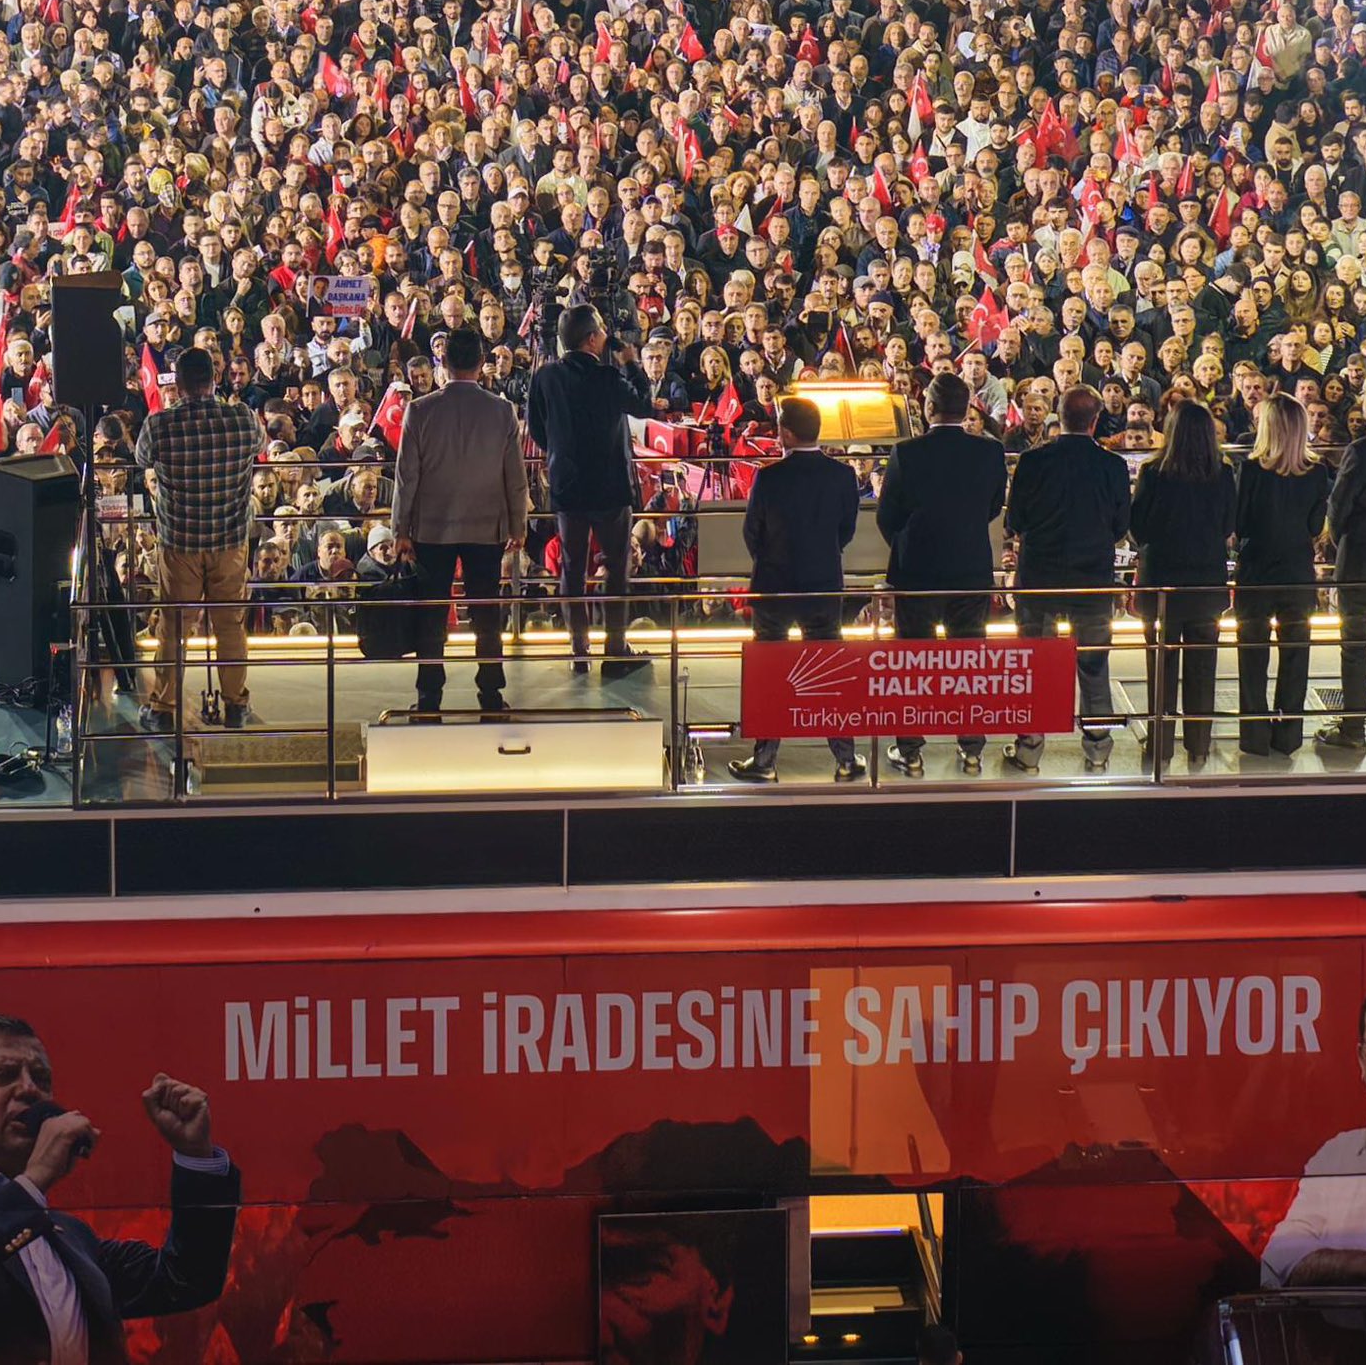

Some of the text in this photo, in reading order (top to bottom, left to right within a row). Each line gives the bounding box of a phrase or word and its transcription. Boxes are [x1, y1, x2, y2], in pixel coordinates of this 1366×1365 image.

[335, 280, 362, 288] AHMET
[868, 645, 1033, 671] CUMHURİYET
[868, 670, 1033, 697] HALK PARTİSİ
[789, 704, 1032, 732] Türkiye'nin Birinci Partisi
[1059, 975, 1322, 1075] ÇIKIYOR
